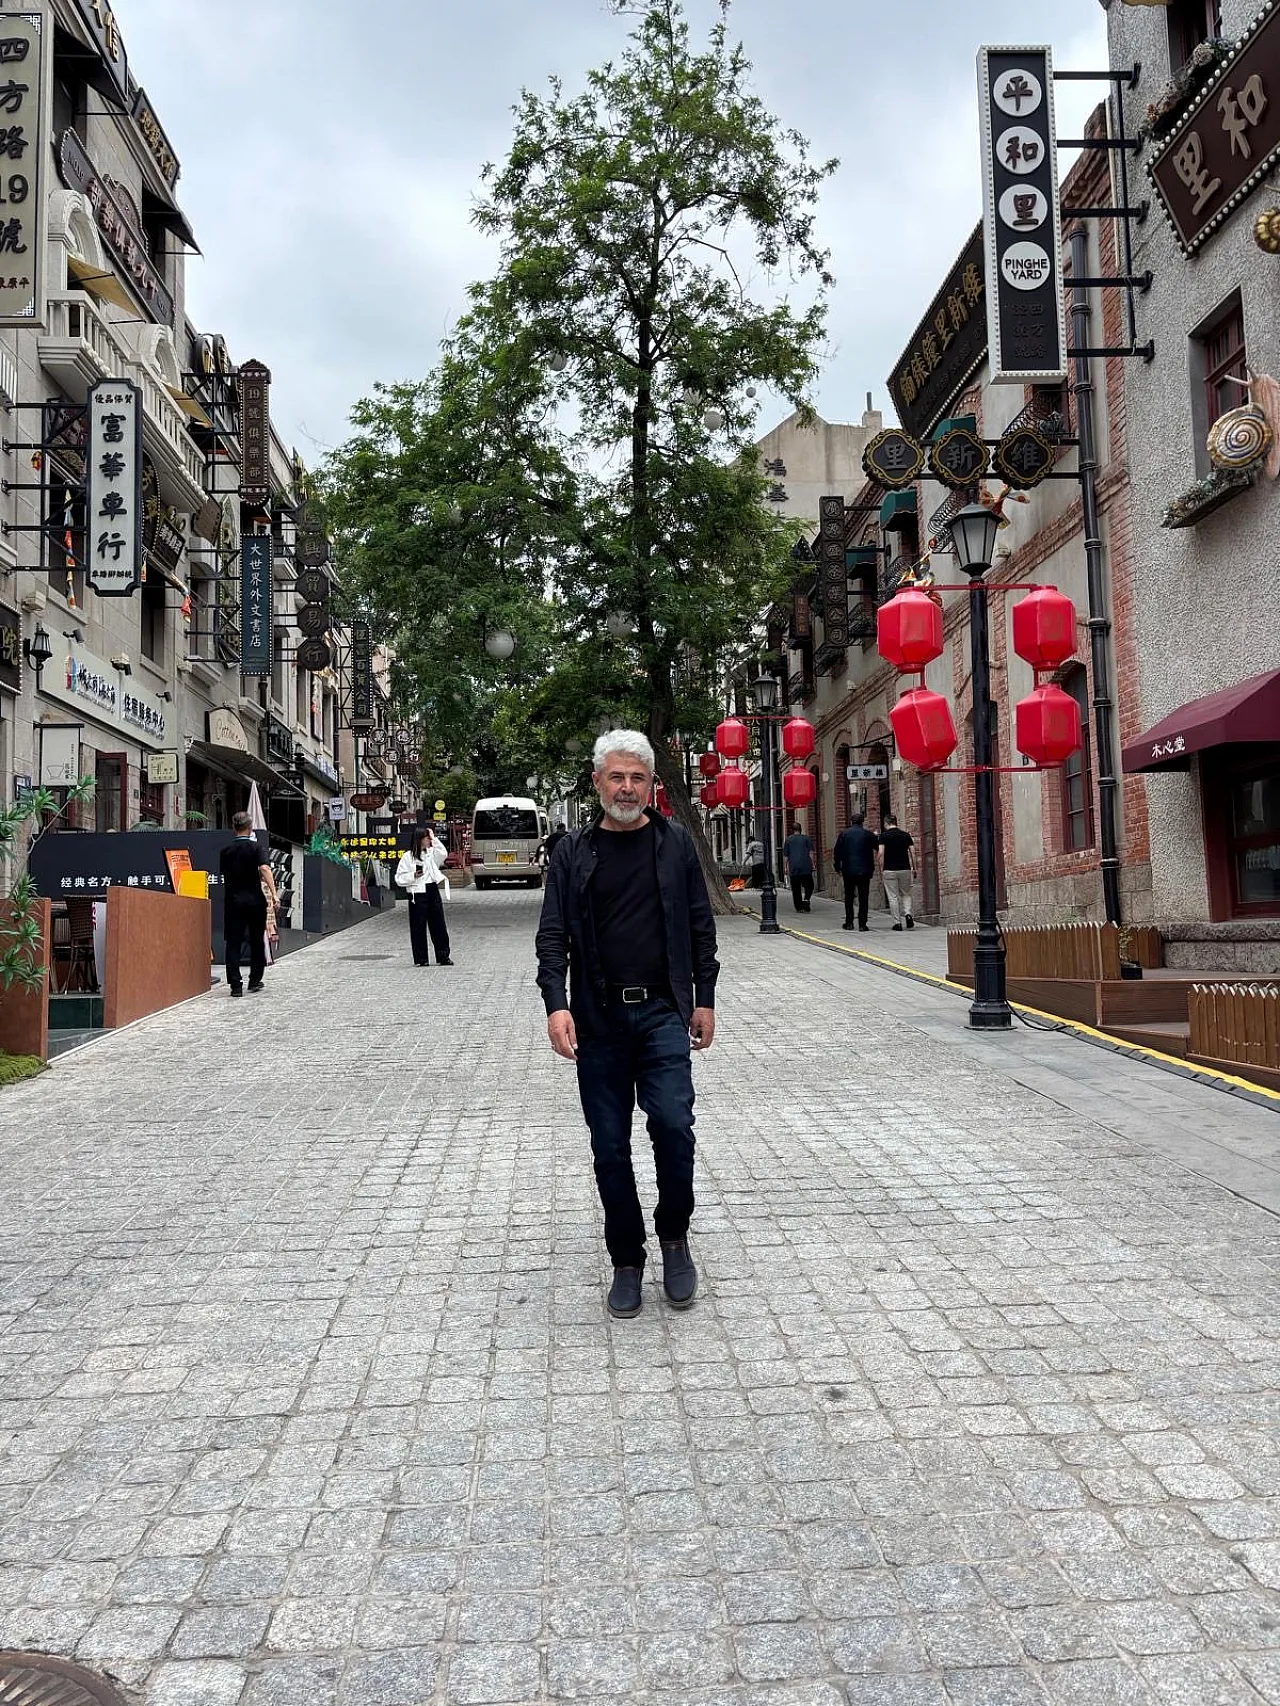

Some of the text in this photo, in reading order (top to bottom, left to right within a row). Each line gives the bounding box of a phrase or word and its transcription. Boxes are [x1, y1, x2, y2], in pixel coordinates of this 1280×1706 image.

[1003, 76, 1039, 226] 平和里
[1005, 258, 1048, 270] PINGHE
[1011, 270, 1042, 280] YARD
[97, 412, 127, 561] 富華車行
[249, 543, 263, 648] 大世界外文書店
[1151, 735, 1186, 758] 木心堂
